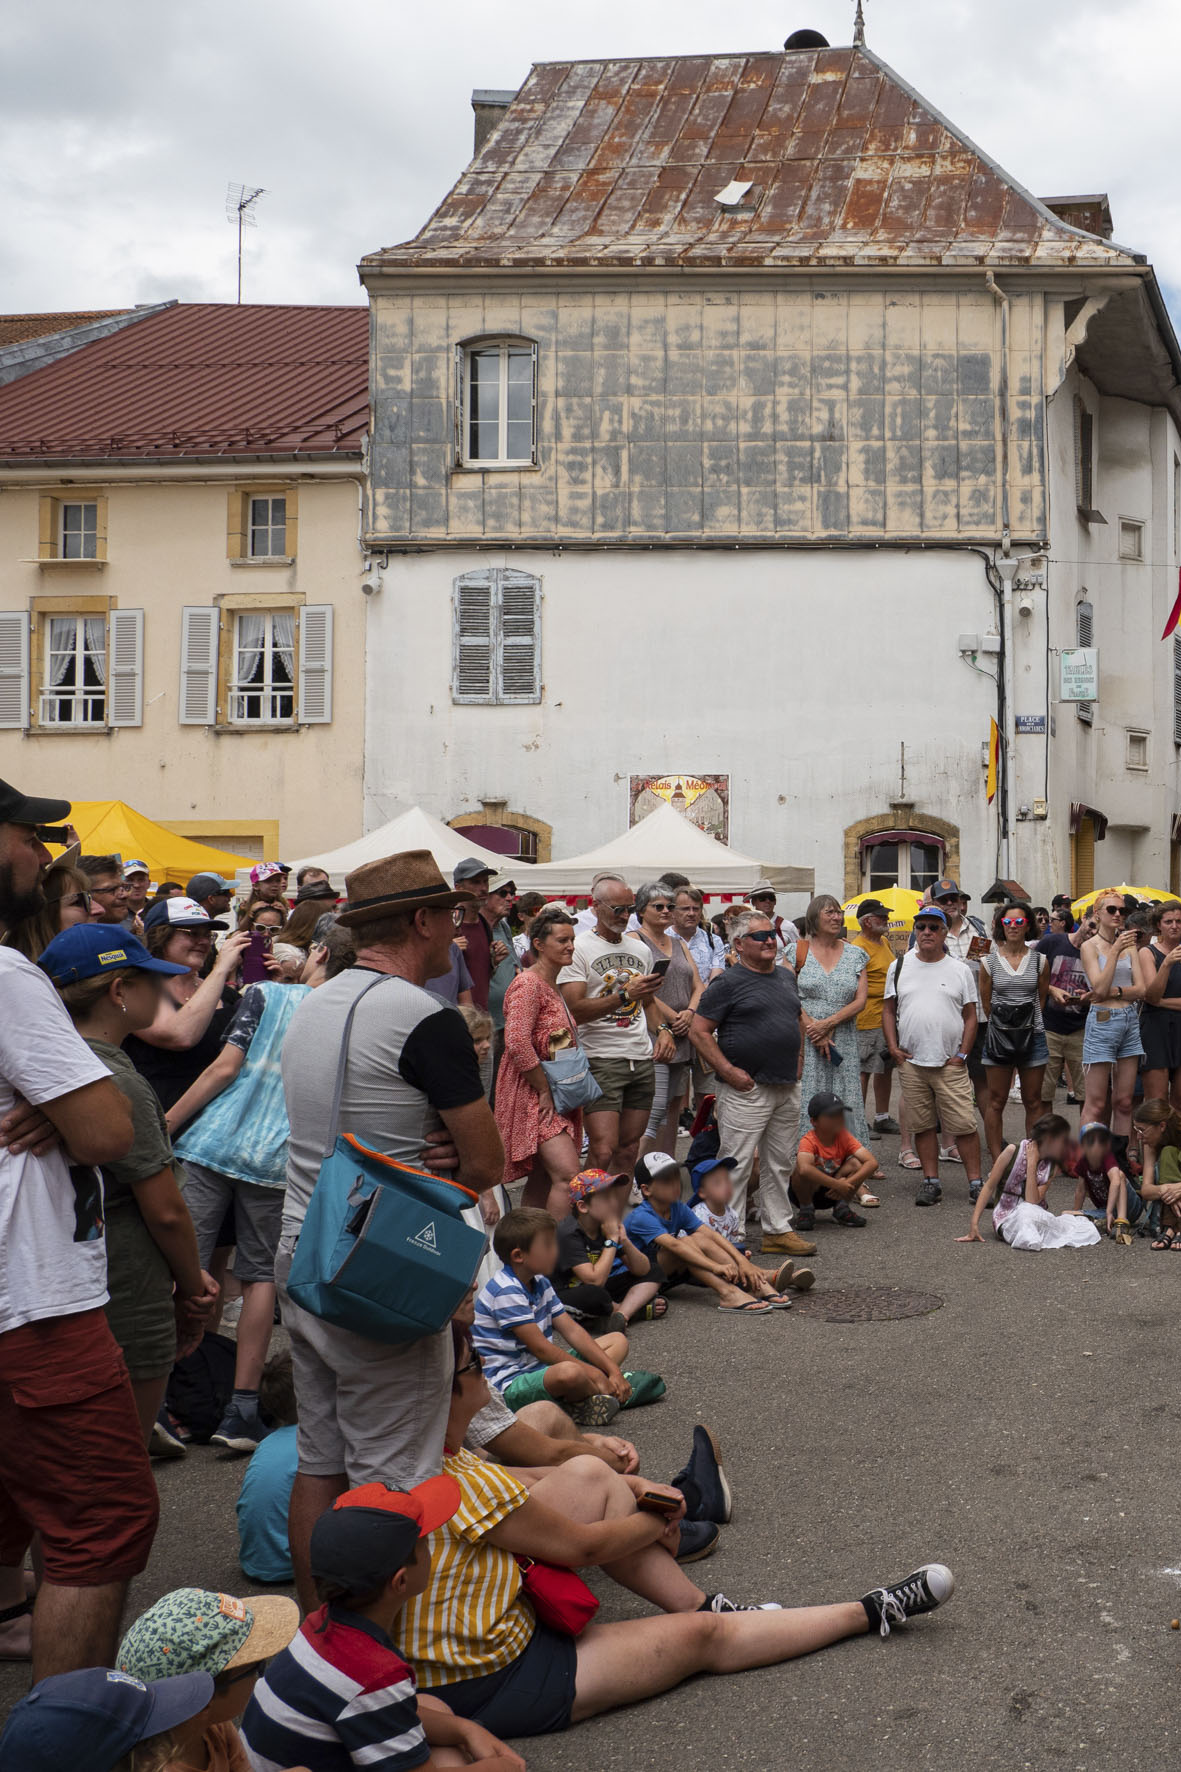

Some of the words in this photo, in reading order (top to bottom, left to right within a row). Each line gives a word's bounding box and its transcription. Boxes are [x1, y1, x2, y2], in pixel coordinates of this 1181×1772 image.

[100, 952, 125, 962] Nesquik
[596, 957, 615, 971] ZZ
[615, 955, 644, 968] TOP
